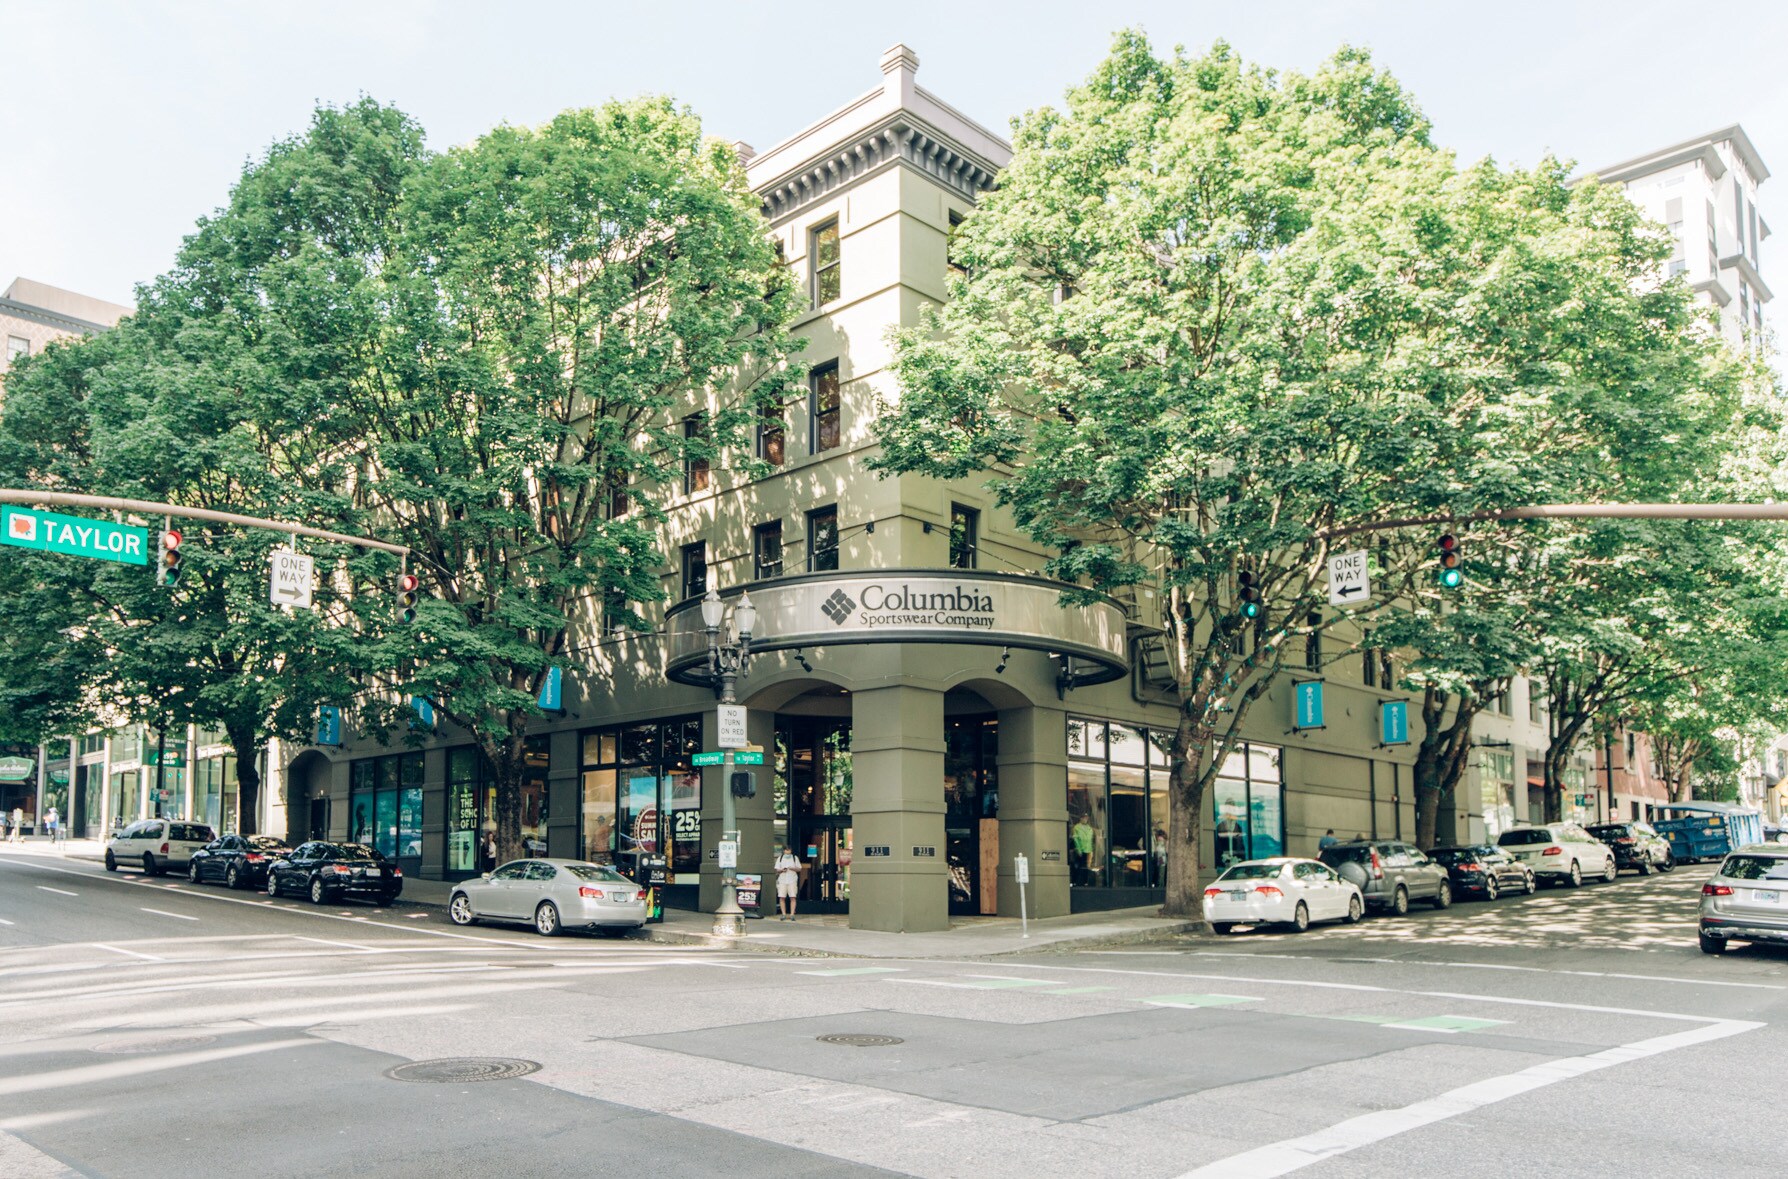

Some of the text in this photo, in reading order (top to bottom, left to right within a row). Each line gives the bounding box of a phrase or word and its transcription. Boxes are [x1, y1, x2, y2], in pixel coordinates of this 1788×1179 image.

[43, 520, 140, 555] TAYLOR
[281, 557, 306, 572] ONE
[1335, 556, 1360, 570] ONE
[279, 570, 306, 584] WAY
[1335, 569, 1361, 583] WAY
[860, 584, 994, 613] Columbia
[860, 611, 995, 630] Sportswear Company
[545, 673, 554, 705] Columbia
[732, 728, 744, 736] RED
[699, 756, 719, 764] Broadway
[742, 755, 755, 764] Taylor
[460, 798, 473, 808] THE
[460, 819, 470, 829] OF
[640, 829, 656, 842] SAL
[738, 891, 757, 901] 25%
